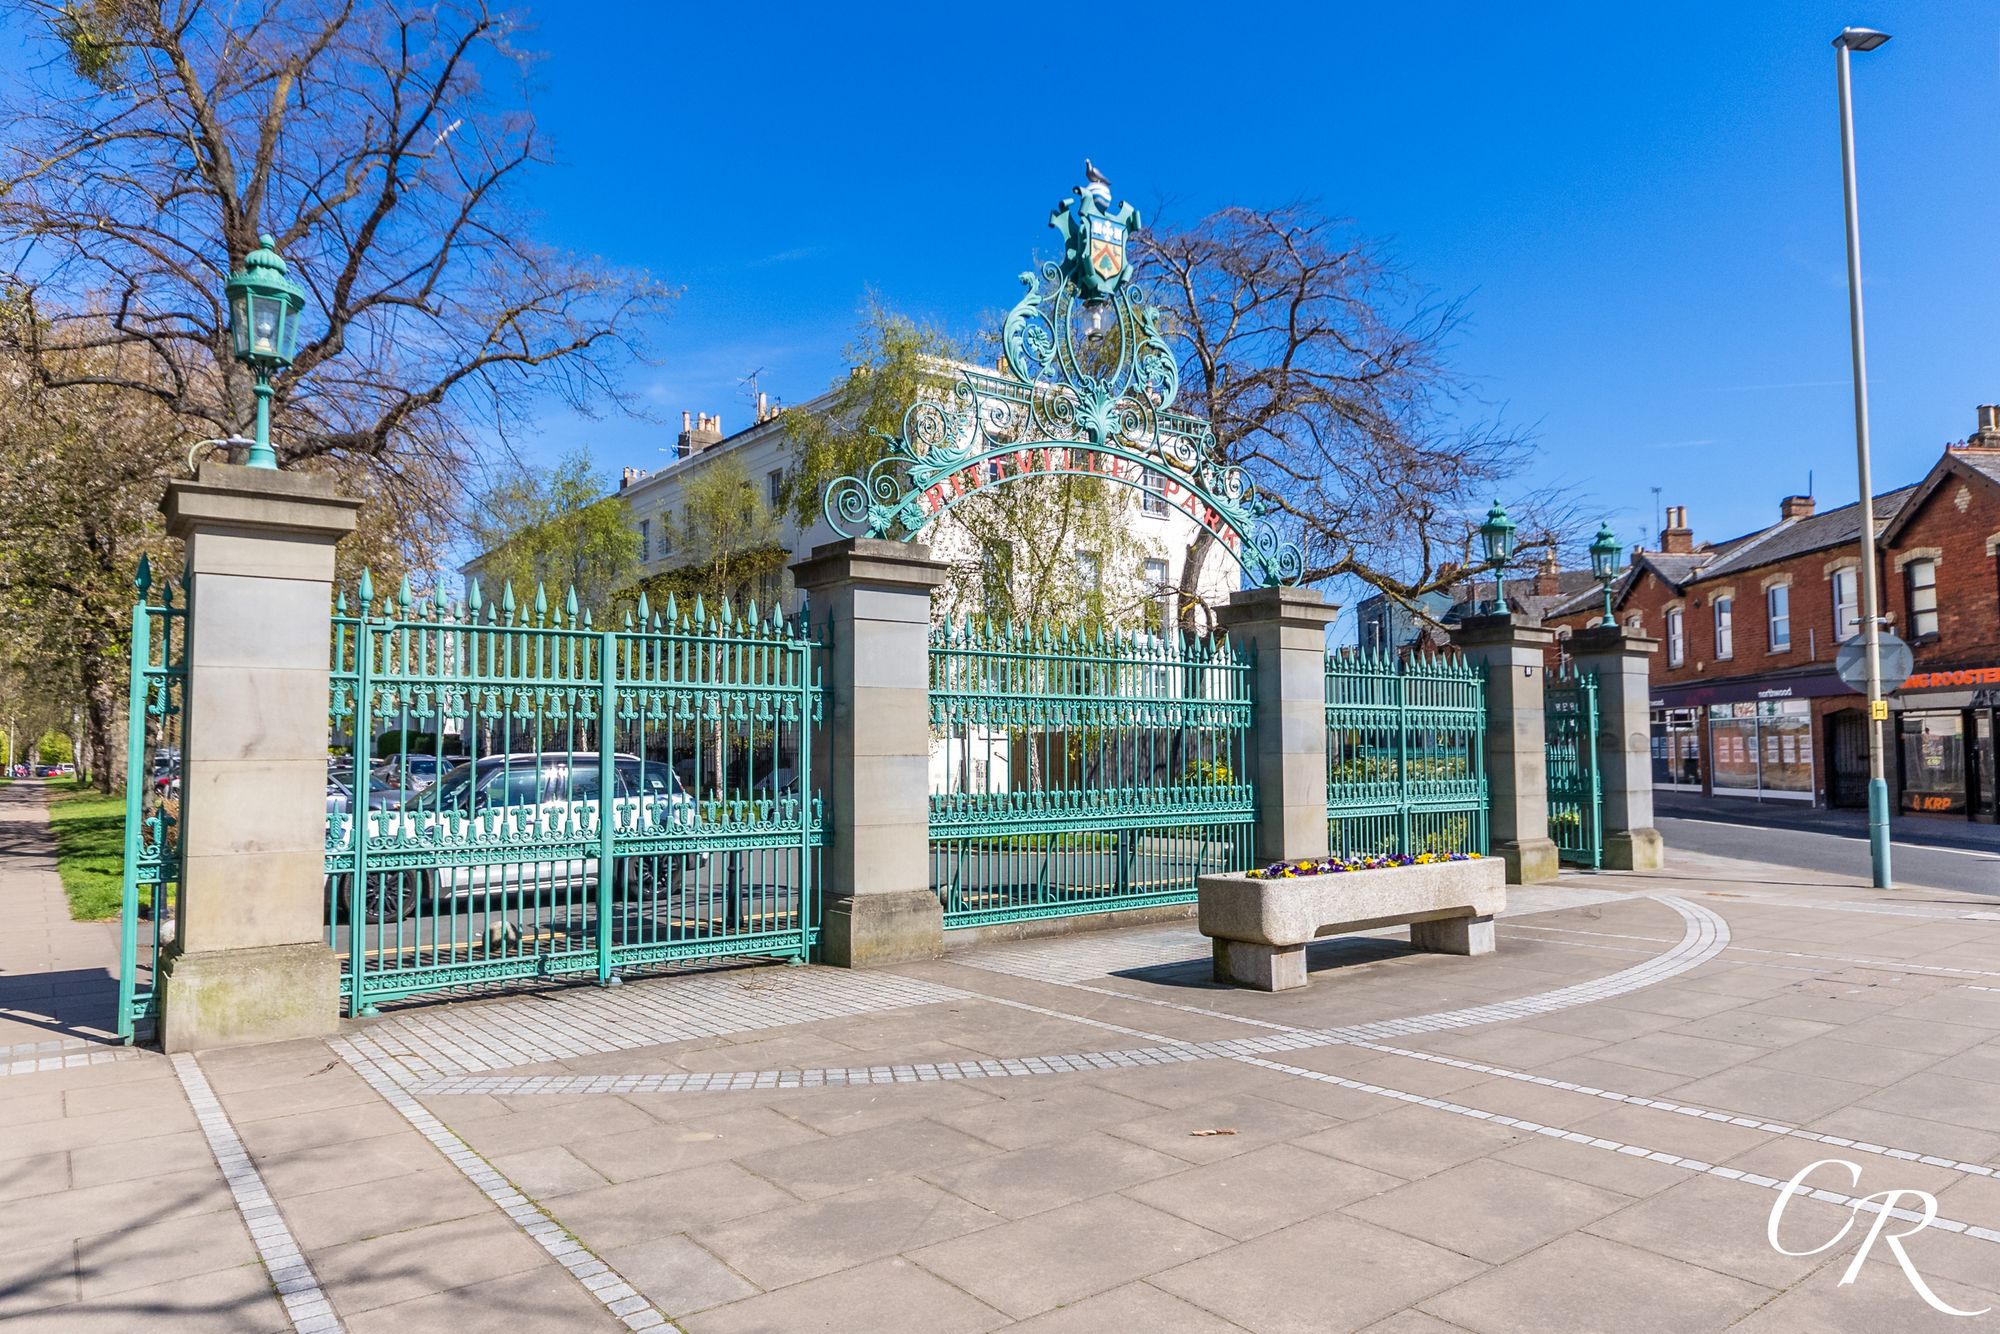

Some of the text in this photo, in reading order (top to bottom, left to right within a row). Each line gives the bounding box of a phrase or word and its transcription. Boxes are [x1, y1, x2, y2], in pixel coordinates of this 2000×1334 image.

[924, 448, 1239, 549] PITTVILLE PARK
[1757, 686, 1793, 698] northwood
[1874, 703, 1886, 717] H
[1923, 797, 1952, 810] KRP
